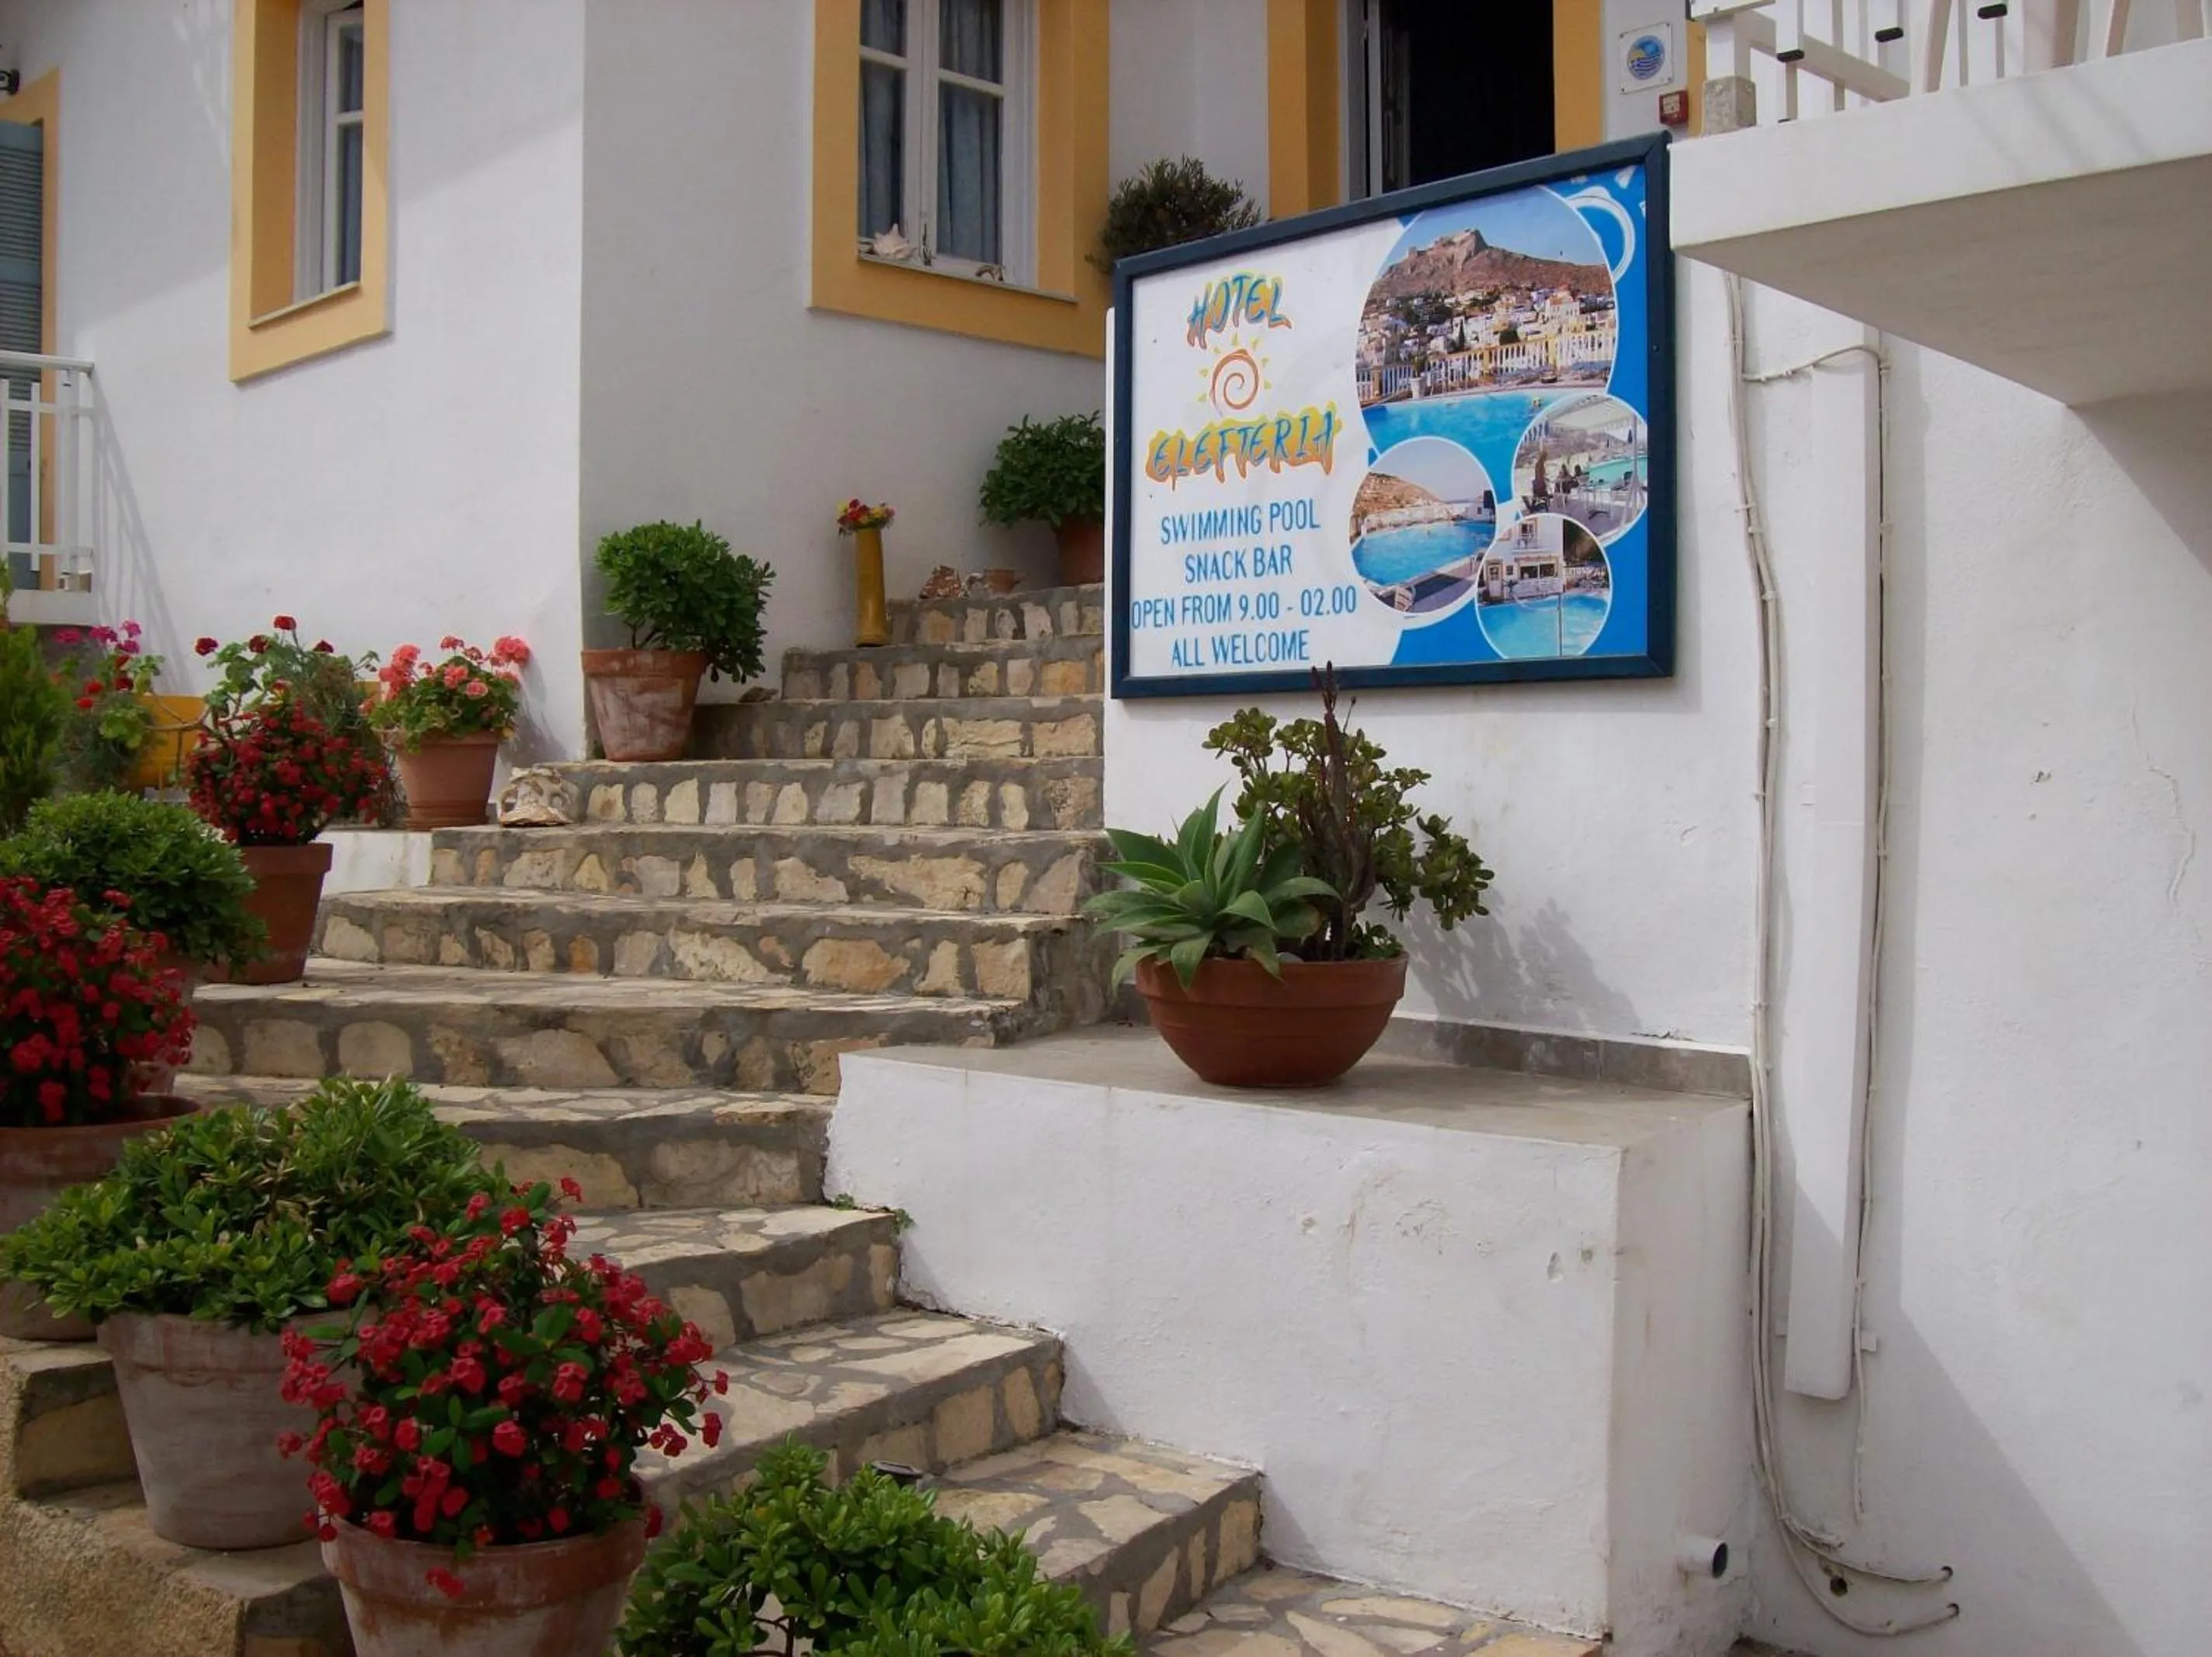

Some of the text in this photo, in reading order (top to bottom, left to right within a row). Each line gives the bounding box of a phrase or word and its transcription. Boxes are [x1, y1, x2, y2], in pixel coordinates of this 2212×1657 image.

[1188, 273, 1292, 348] HOTEL
[1146, 402, 1341, 488] ELEFTERIA
[1160, 499, 1320, 544] SWIMMING POOL
[1184, 544, 1292, 582] SNACK BAR
[1132, 598, 1175, 629] OPEN
[1181, 593, 1232, 625] FROM
[1239, 592, 1279, 621] 9.00
[1300, 585, 1356, 616] 02.00
[1171, 630, 1310, 667] ALL WELCOME
